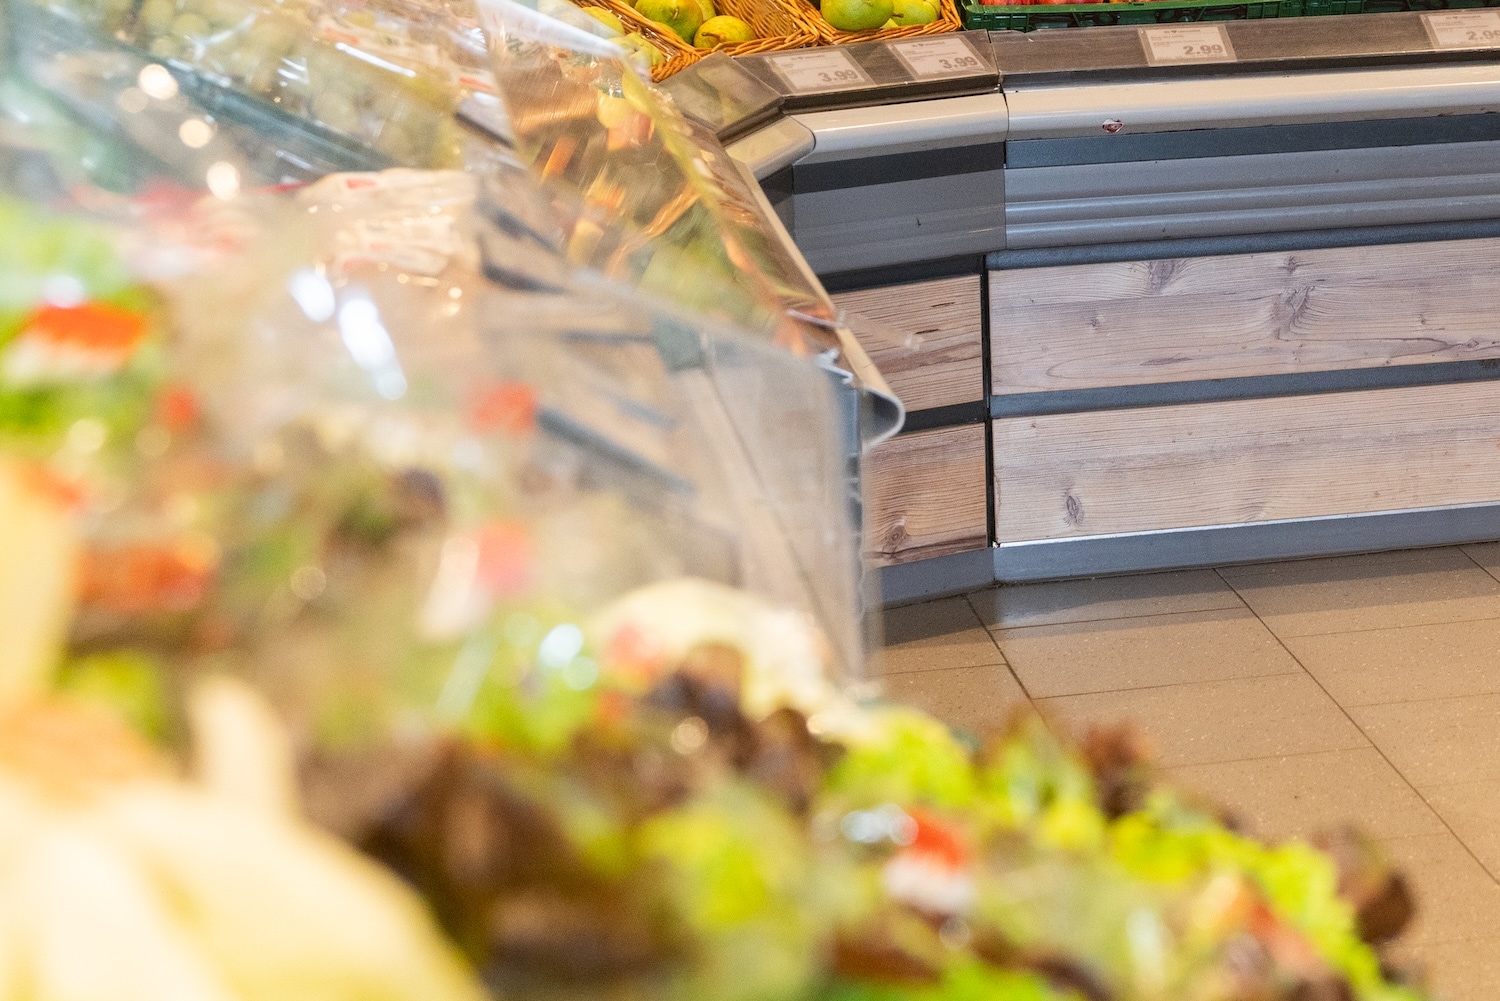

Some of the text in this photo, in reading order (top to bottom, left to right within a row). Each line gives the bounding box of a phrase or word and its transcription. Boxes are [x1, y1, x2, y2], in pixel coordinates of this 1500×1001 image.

[1183, 44, 1223, 55] 2.99
[938, 56, 978, 69] 3.99
[818, 69, 859, 83] 3.99
